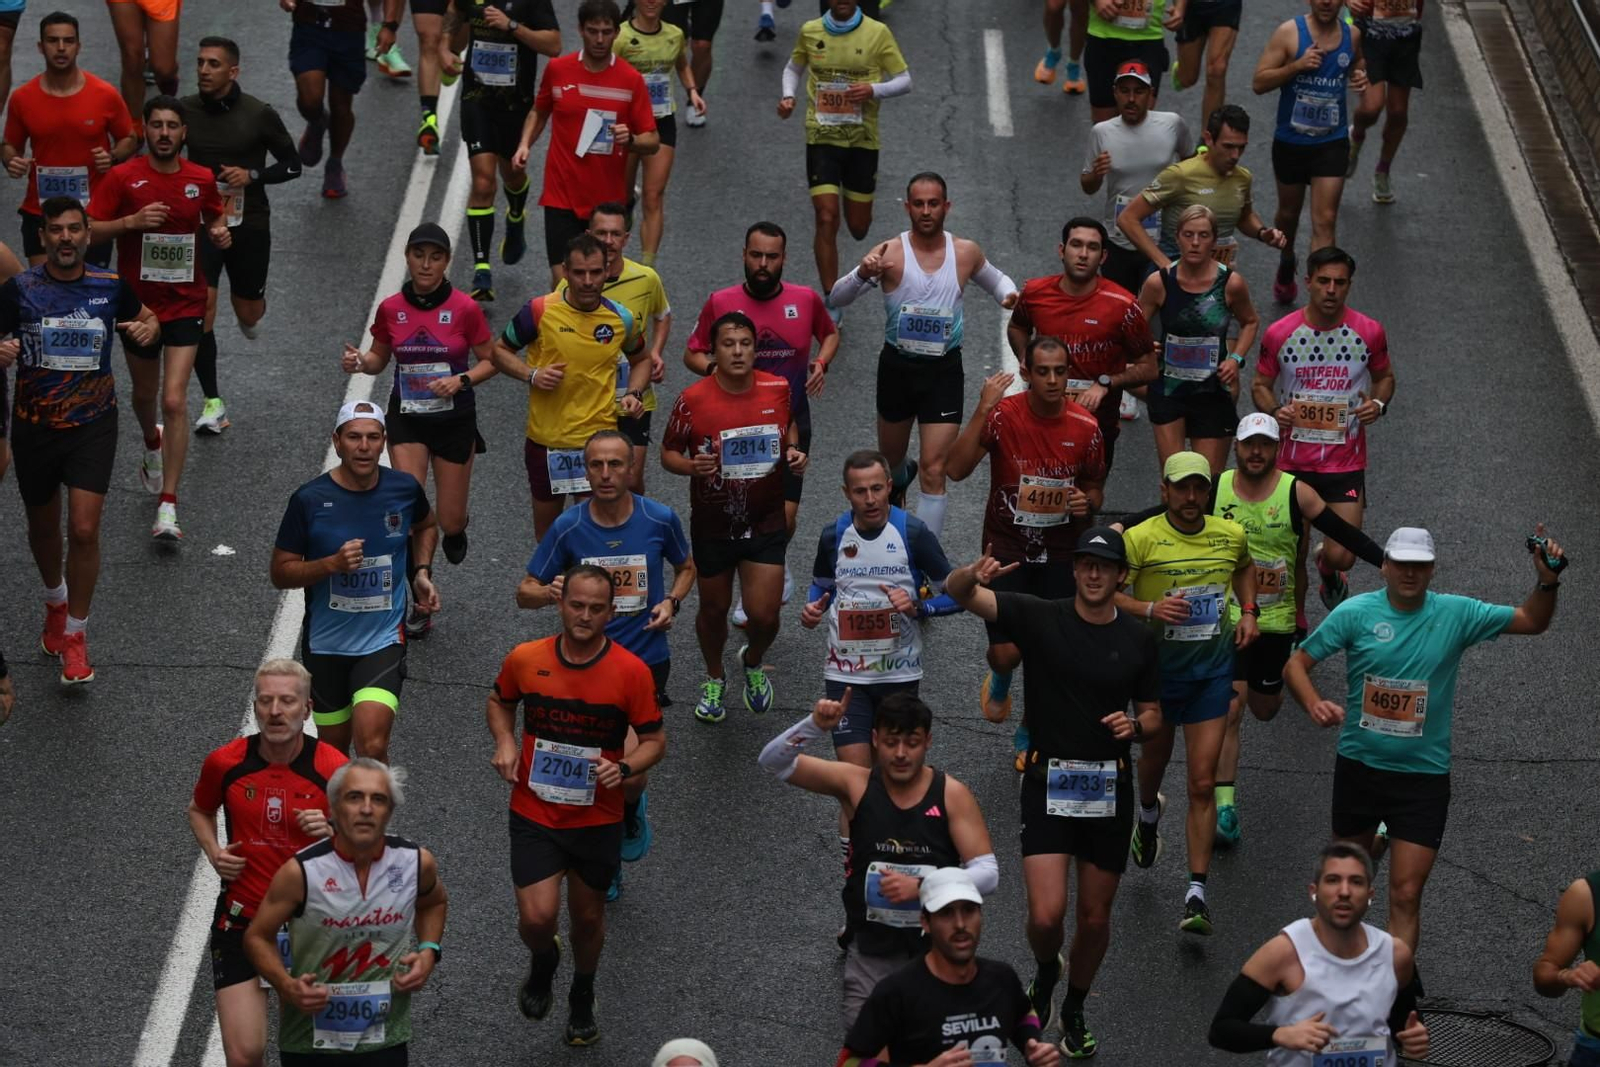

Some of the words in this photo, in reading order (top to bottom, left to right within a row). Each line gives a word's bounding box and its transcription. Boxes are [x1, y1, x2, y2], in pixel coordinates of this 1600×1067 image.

[477, 53, 506, 68] 2296
[45, 178, 77, 192] 2315
[151, 246, 184, 261] 6560
[89, 297, 109, 306] HOKA
[907, 317, 940, 334] 3056
[50, 331, 89, 348] 2286
[1295, 365, 1349, 378] ENTRENA
[1300, 405, 1335, 422] 3615
[731, 439, 767, 456] 2814
[557, 455, 585, 471] 204
[1027, 489, 1063, 506] 4110
[340, 570, 378, 589] 3070
[612, 570, 633, 587] 62
[868, 566, 907, 576] ATLETISMO
[1258, 570, 1275, 586] 12
[847, 613, 886, 631] 1255
[1370, 692, 1412, 712] 4697
[541, 756, 583, 779] 2704
[1058, 774, 1100, 791] 2733
[322, 907, 404, 928] maratón
[325, 1000, 373, 1021] 2946
[942, 1016, 1001, 1036] SEVILLA
